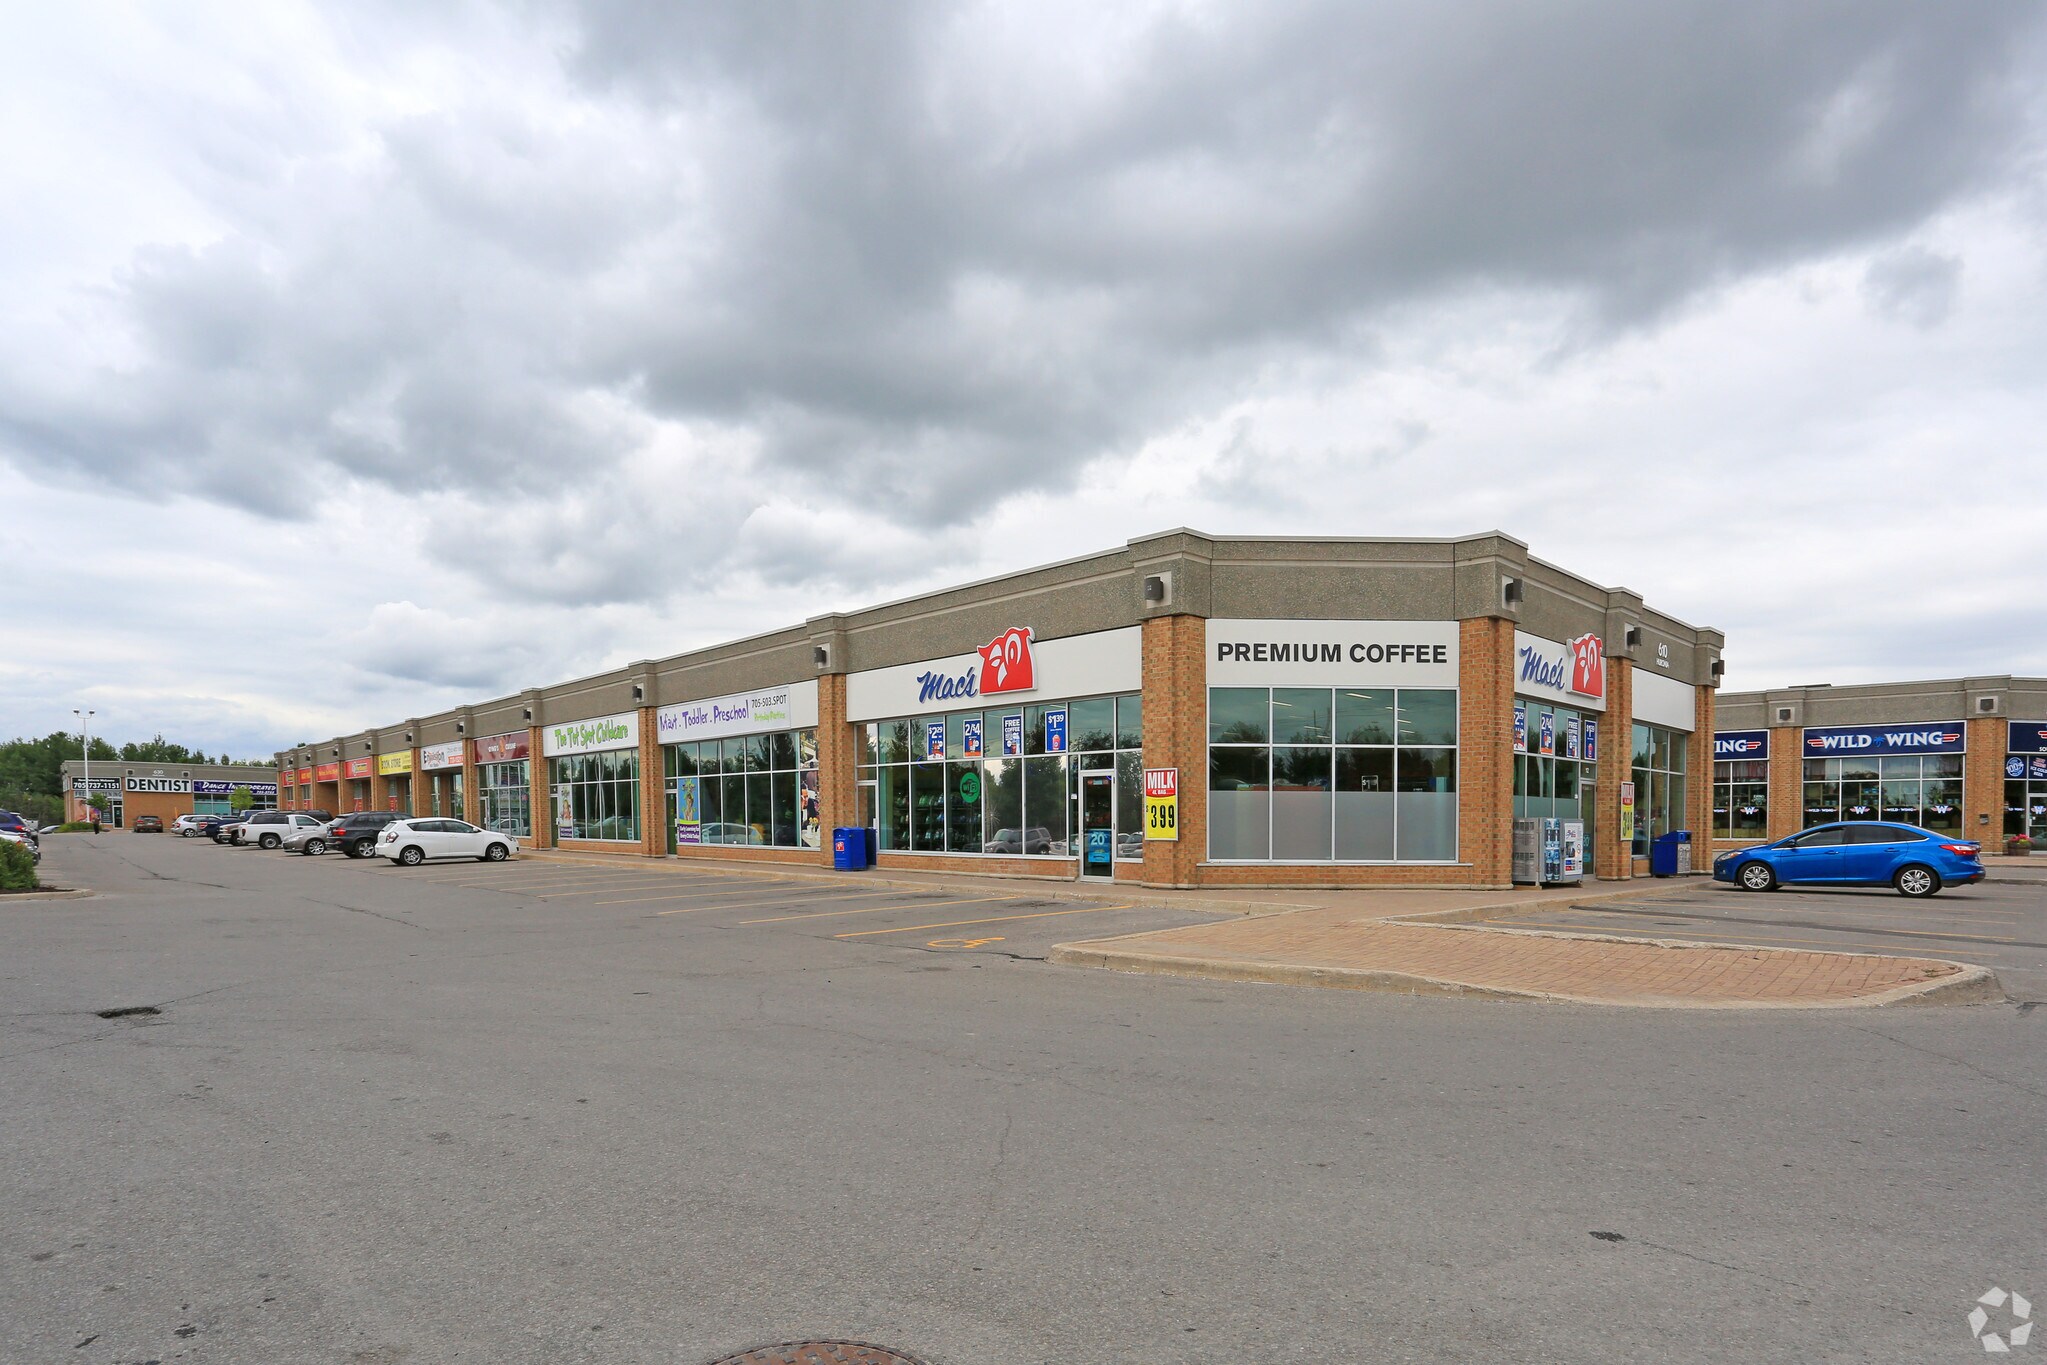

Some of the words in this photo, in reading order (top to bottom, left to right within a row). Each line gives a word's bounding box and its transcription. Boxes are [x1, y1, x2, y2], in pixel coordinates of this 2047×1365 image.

[1217, 642, 1341, 662] PREMIUM
[1349, 644, 1448, 663] COFFEE
[1658, 642, 1668, 658] 610
[1520, 645, 1565, 690] Mac's
[917, 666, 978, 704] Mac's
[660, 713, 677, 731] Infant
[682, 707, 708, 729] Toddler
[713, 700, 749, 724] Preschool
[1005, 719, 1020, 727] FREE
[554, 728, 566, 749] The
[567, 727, 579, 748] Tot
[580, 724, 595, 749] Spot
[596, 719, 628, 743] Childcare
[1820, 734, 1872, 749] WILD
[1884, 731, 1943, 746] WING
[1714, 740, 1747, 753] ING
[127, 778, 189, 791] DENTIST
[1147, 771, 1174, 789] MILK
